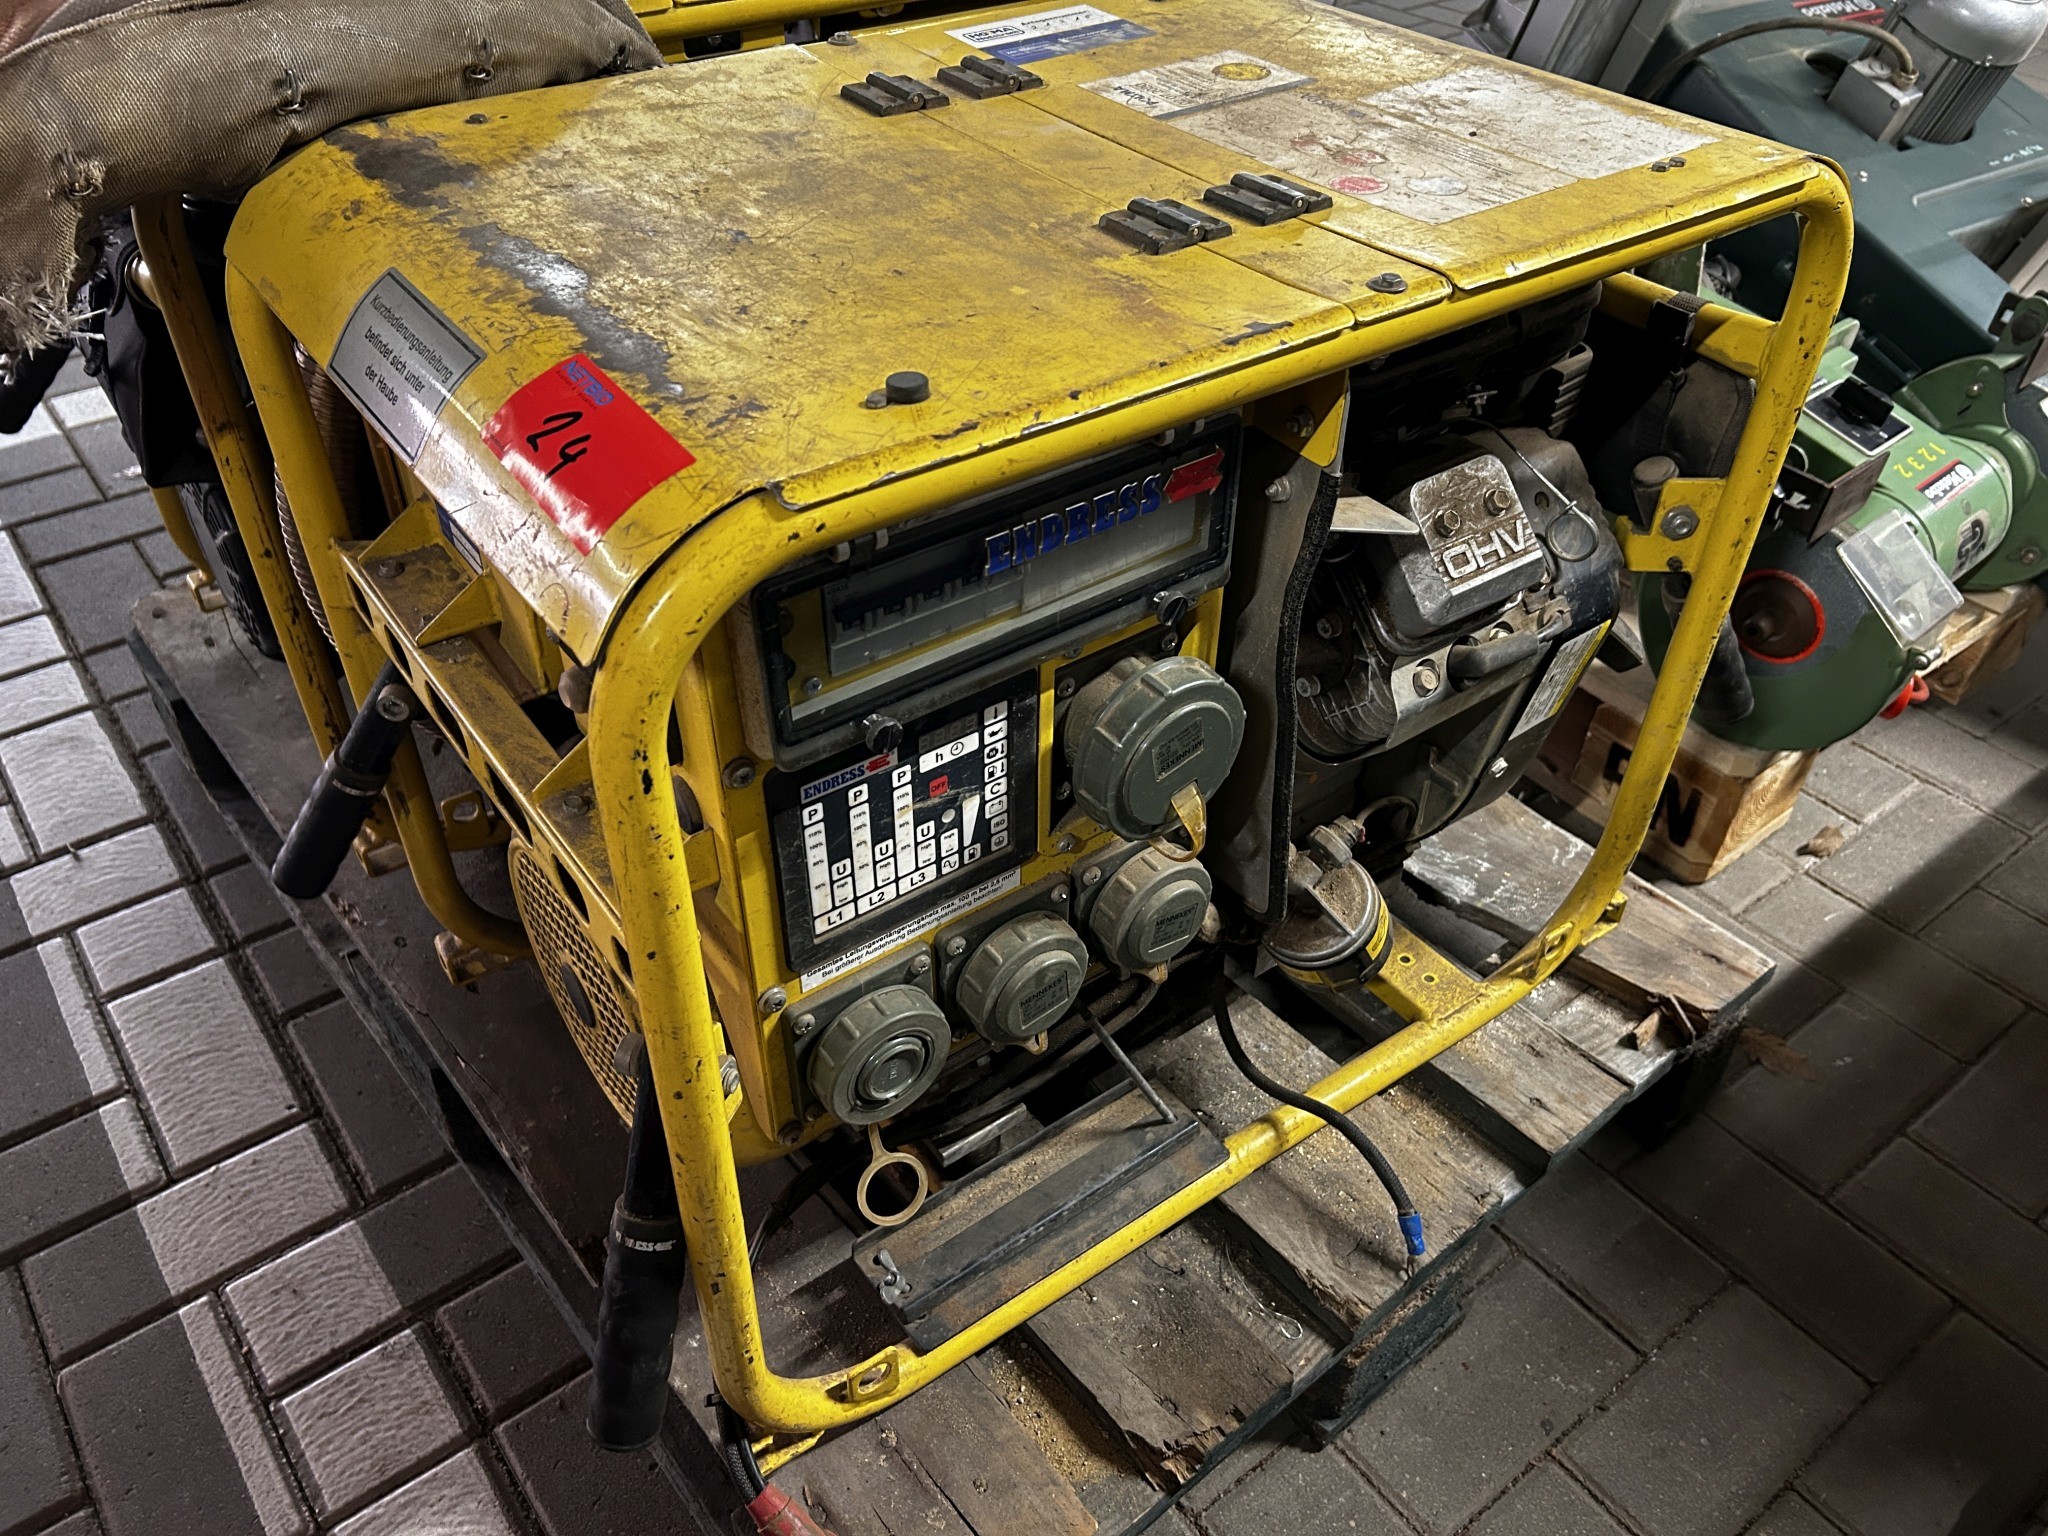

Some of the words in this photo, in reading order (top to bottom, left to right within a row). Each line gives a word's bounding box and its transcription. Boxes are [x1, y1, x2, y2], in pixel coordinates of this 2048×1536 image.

[369, 293, 454, 384] Kurzbedienungsanleitung
[364, 325, 393, 362] befindet
[392, 354, 407, 377] sich
[404, 369, 426, 394] unter
[364, 364, 377, 383] der
[376, 375, 399, 406] Haube
[526, 411, 592, 481] 24
[1893, 442, 1946, 479] 1232
[985, 473, 1161, 576] ENDRESS
[1443, 519, 1526, 579] OHV
[935, 752, 944, 763] h
[1160, 739, 1203, 773] MENNEKES
[803, 764, 865, 800] ENDRESS
[897, 770, 906, 783] P
[931, 783, 946, 792] OFF
[990, 782, 1001, 794] C
[853, 790, 863, 802] P
[808, 808, 818, 821] P
[921, 825, 930, 837] U
[993, 818, 1005, 828] ISO
[879, 843, 889, 856] U
[836, 863, 847, 875] U
[910, 872, 926, 887] L3
[869, 891, 885, 907] L2
[827, 912, 843, 926] L1
[806, 955, 844, 977] Gesamtes
[940, 901, 957, 912] max.
[958, 893, 970, 903] 100
[978, 885, 989, 893] bei
[821, 969, 834, 978] Bei
[834, 953, 864, 971] größerer
[864, 931, 906, 957] Ausdehnung
[906, 900, 973, 936] Bedienungsanleitung
[973, 883, 1004, 903] beachten!
[1020, 979, 1063, 1008] MENNEKES
